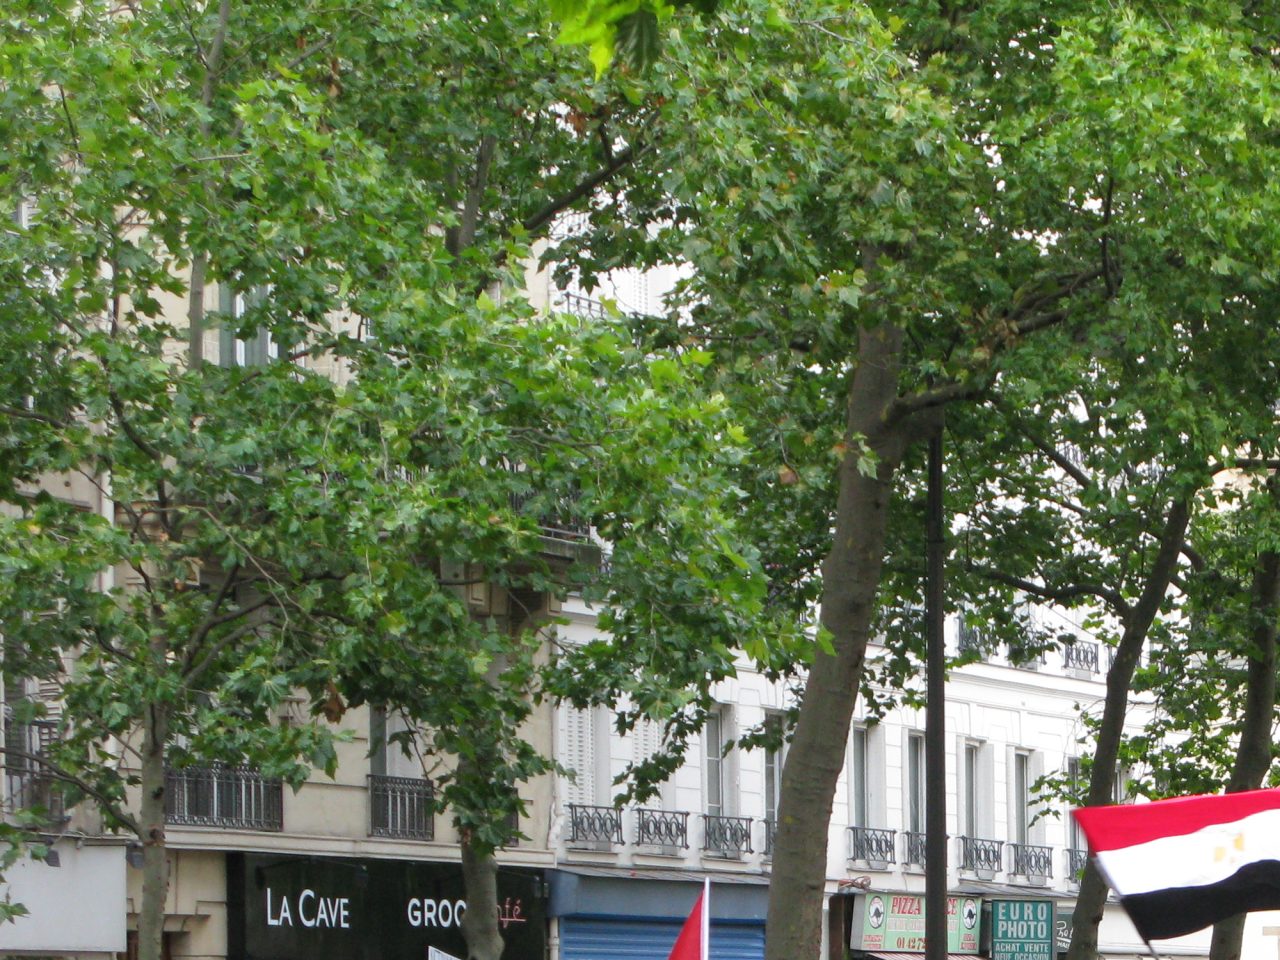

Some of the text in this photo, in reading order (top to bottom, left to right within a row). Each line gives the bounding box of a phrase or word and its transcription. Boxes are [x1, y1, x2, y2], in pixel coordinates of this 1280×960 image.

[266, 887, 350, 929] LA CAVE
[891, 896, 922, 915] PIZZA
[998, 902, 1047, 920] EURO
[997, 921, 1047, 939] PHOTO
[995, 942, 1049, 953] ACHAT VENTE
